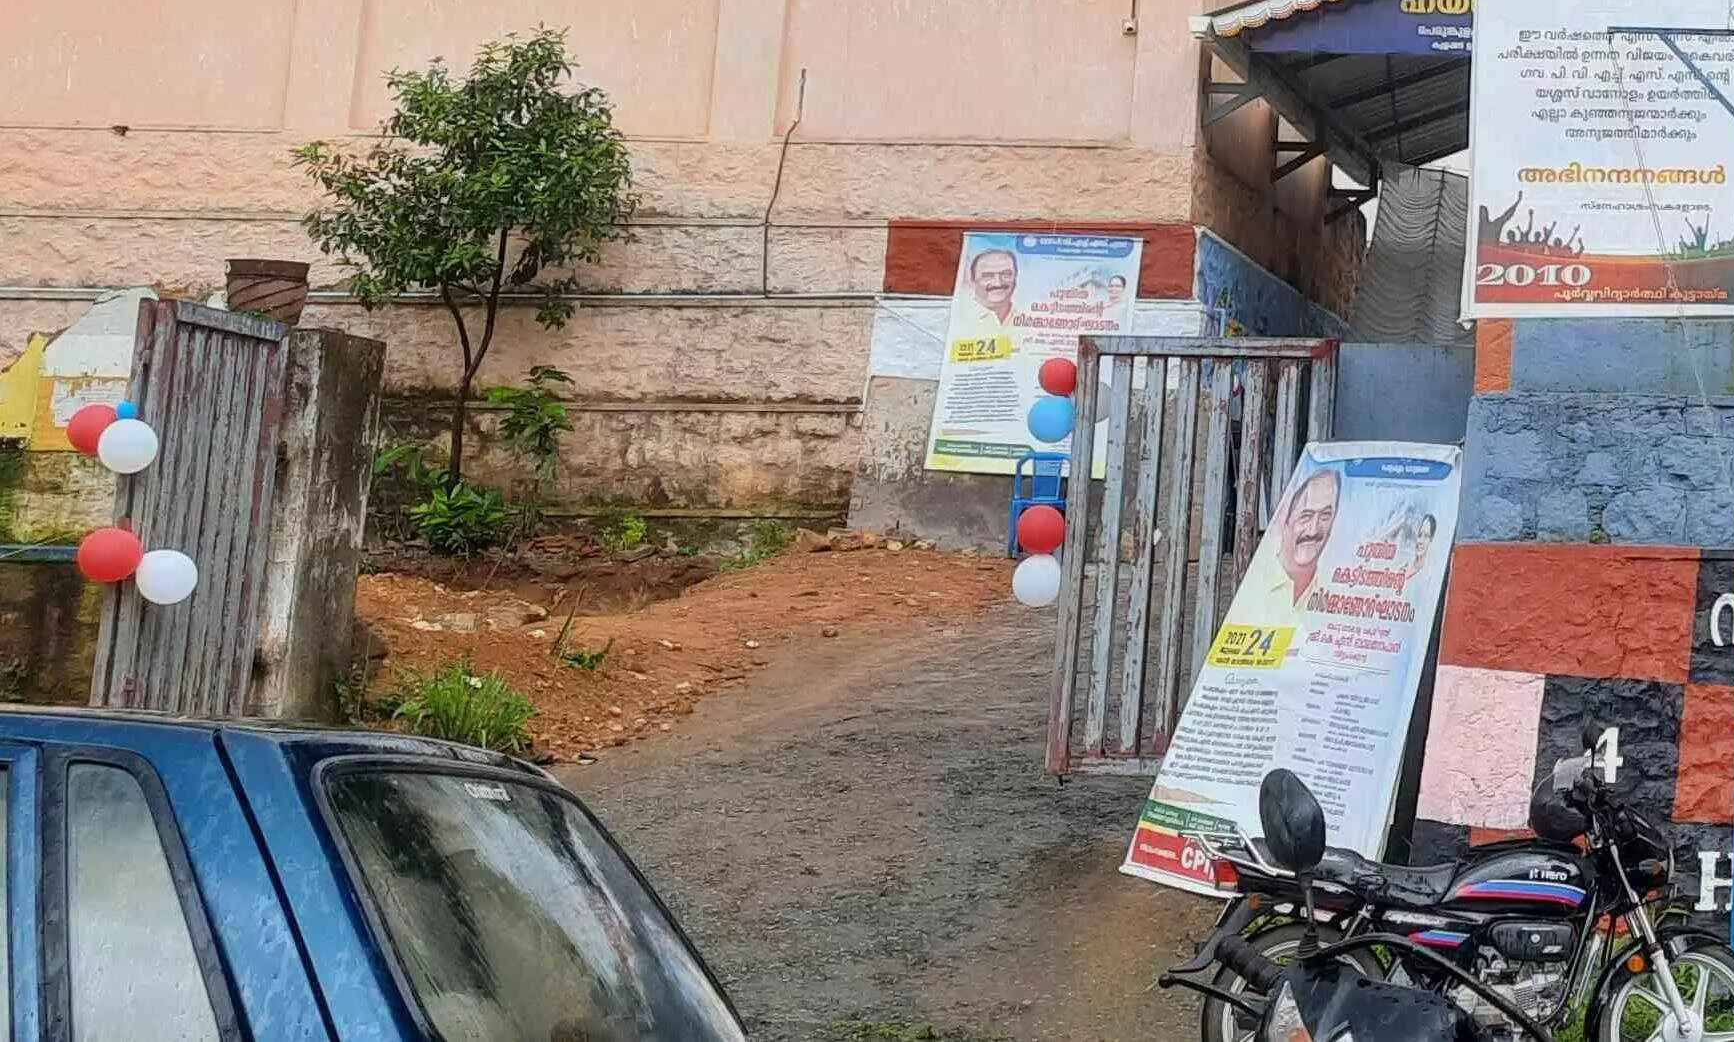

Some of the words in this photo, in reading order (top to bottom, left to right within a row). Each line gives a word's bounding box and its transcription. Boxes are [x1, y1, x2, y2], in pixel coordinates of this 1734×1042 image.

[1626, 46, 1674, 61] വിജയം
[1531, 108, 1567, 123] എല്ലാ
[1517, 161, 1727, 185] അഭിനന്ദനങ്ങൾ
[1476, 263, 1592, 286] 2010
[976, 338, 997, 356] 24
[1242, 629, 1277, 656] 24
